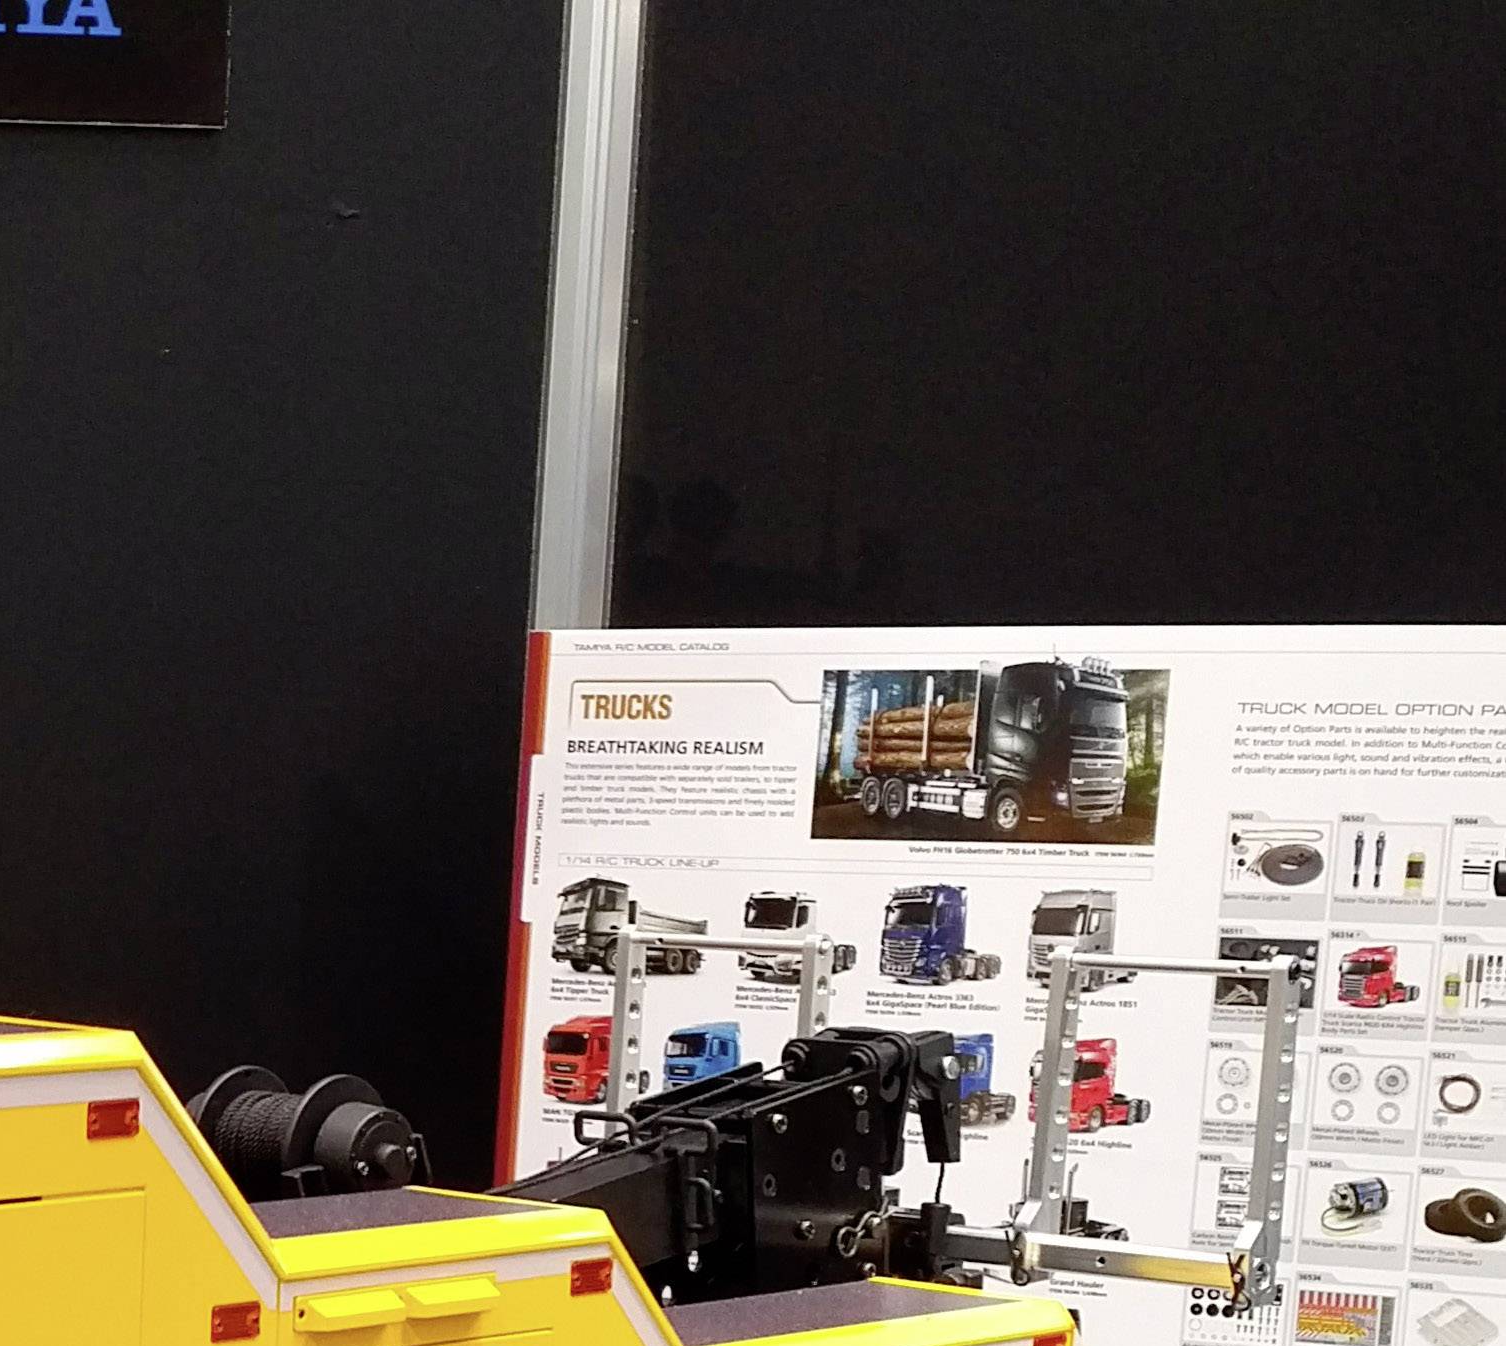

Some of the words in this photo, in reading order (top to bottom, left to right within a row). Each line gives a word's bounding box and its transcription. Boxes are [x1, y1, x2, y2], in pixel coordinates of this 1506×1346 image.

[581, 694, 673, 720] TRUCKS
[1237, 702, 1307, 714] TRUCK
[1313, 703, 1387, 715] MODEL
[1395, 704, 1473, 716] OPTION
[567, 740, 687, 755] BREATHTAKING
[693, 742, 764, 755] REALISM
